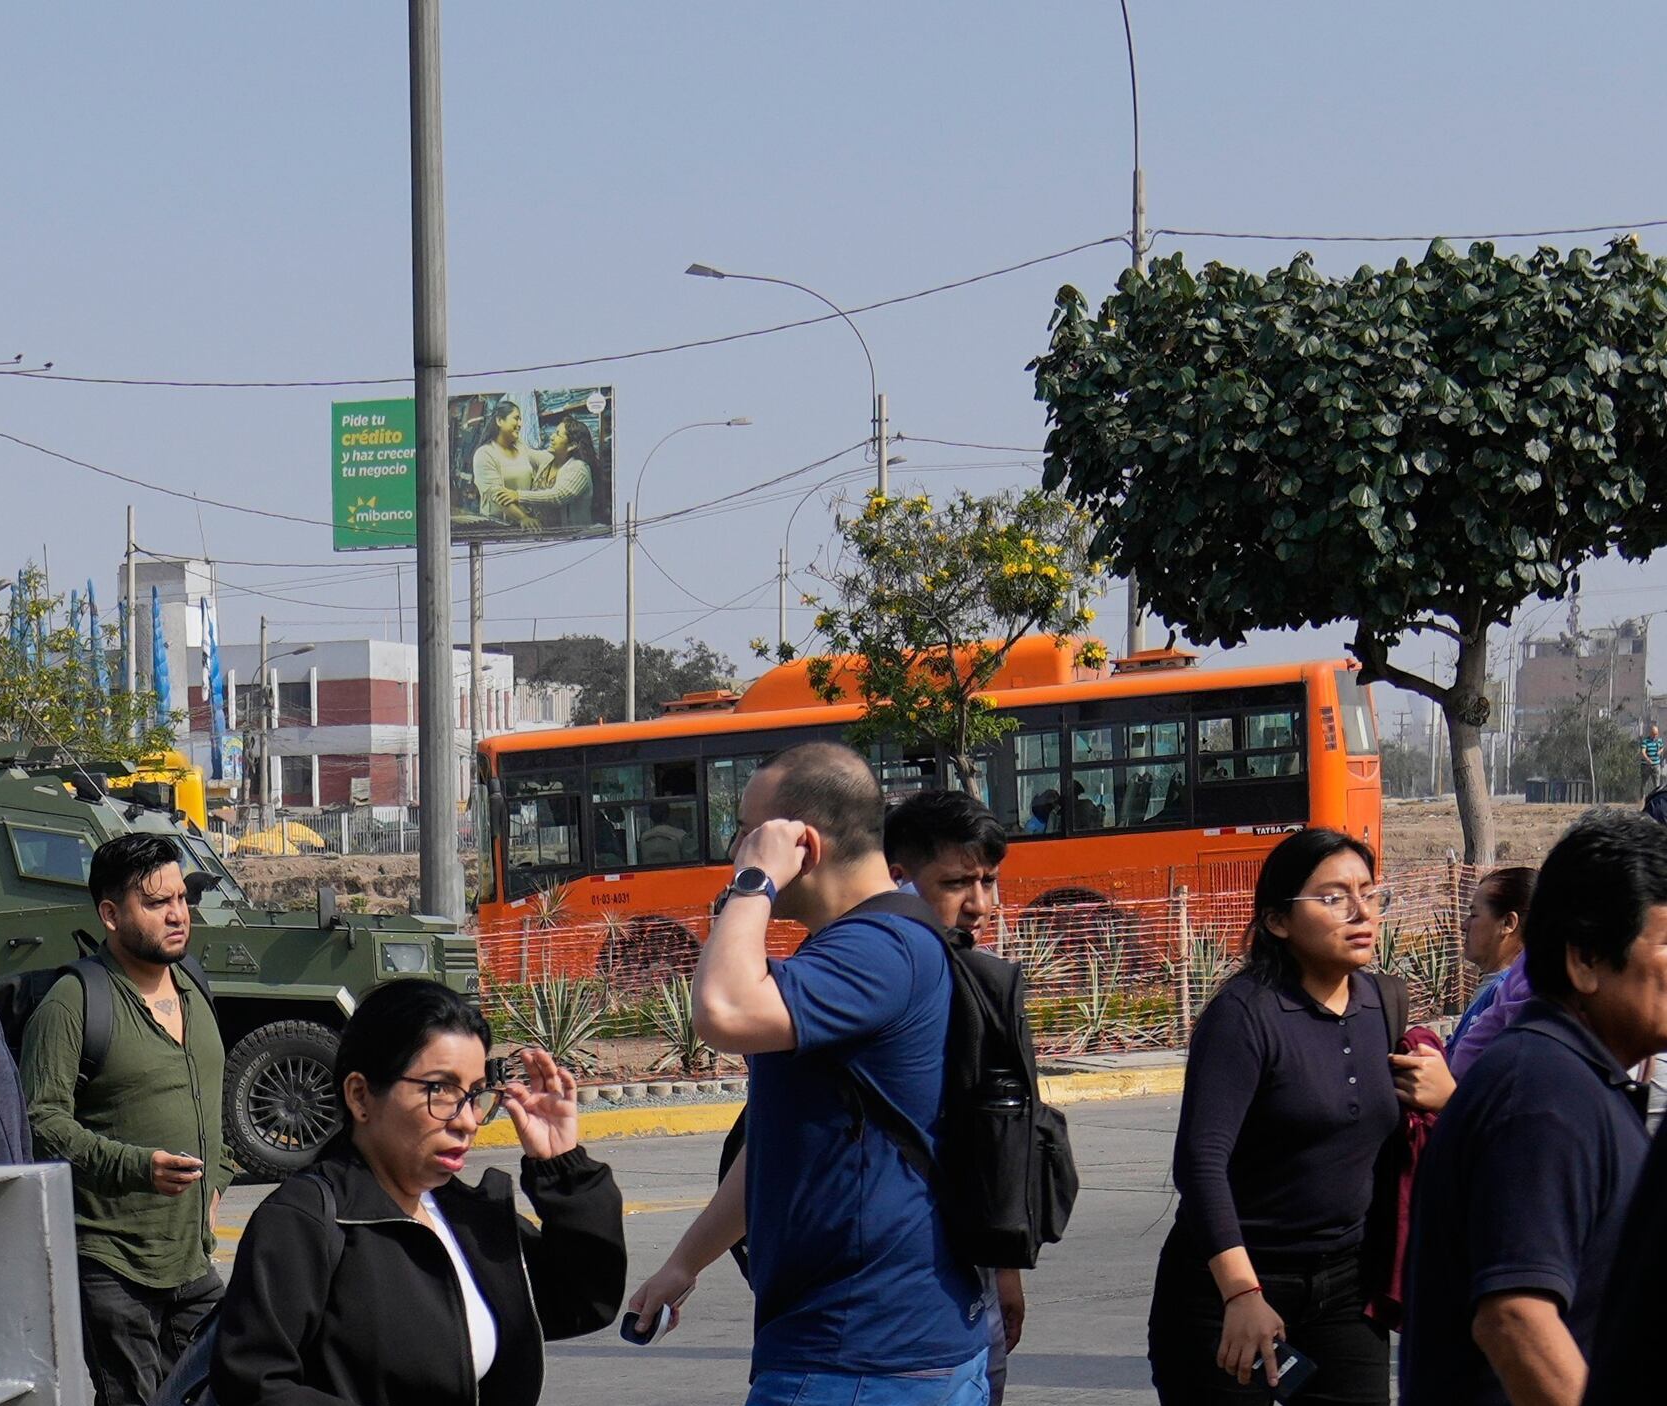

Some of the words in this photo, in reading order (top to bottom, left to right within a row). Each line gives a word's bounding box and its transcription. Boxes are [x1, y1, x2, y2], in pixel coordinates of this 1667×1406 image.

[342, 414, 369, 427] Pide
[372, 415, 386, 426] tu
[341, 429, 403, 446] crédito
[341, 452, 350, 464] y
[353, 450, 374, 461] haz
[377, 448, 416, 460] crecer
[342, 466, 356, 477] tu
[359, 462, 408, 478] negocio
[356, 510, 413, 522] mibanco
[1256, 826, 1281, 835] TATSA
